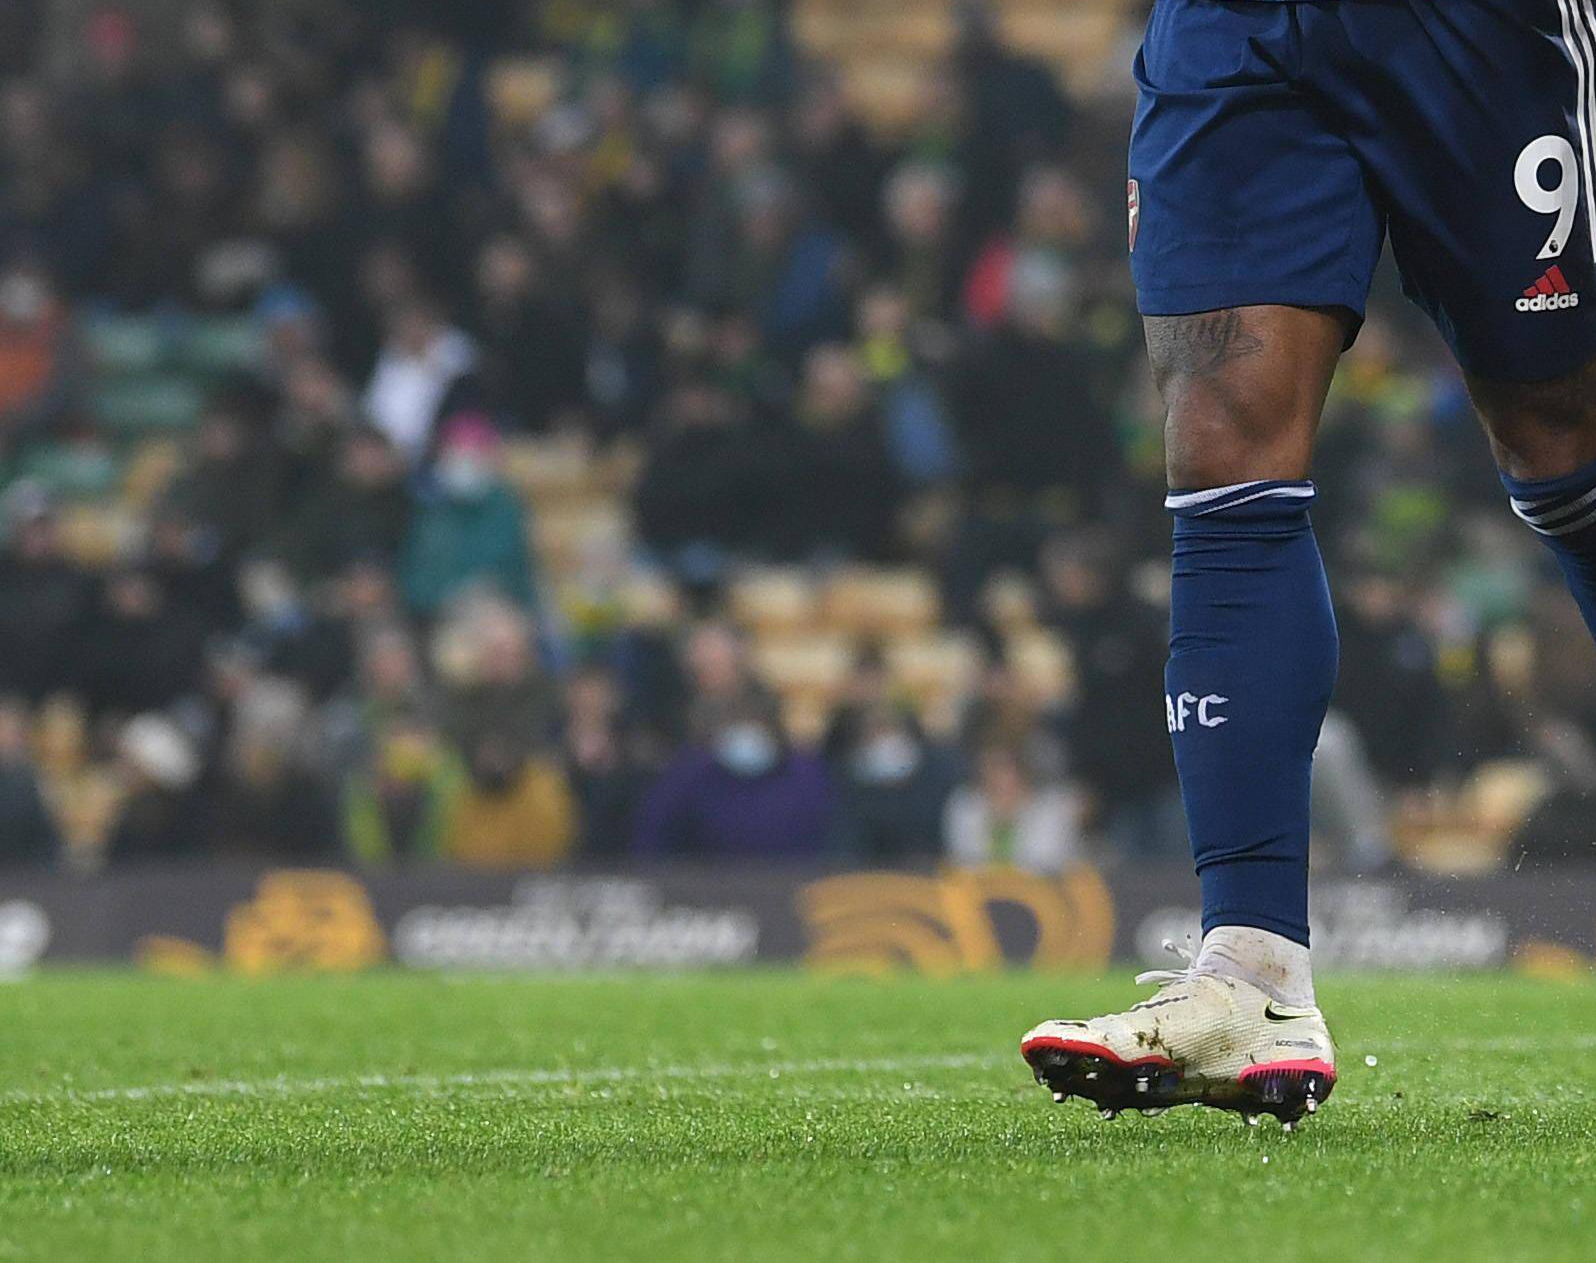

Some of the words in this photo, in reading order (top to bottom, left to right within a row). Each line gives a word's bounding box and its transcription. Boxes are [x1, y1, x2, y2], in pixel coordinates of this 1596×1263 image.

[1514, 134, 1579, 260] 9
[1515, 292, 1579, 312] adidas
[1165, 691, 1229, 734] AFC
